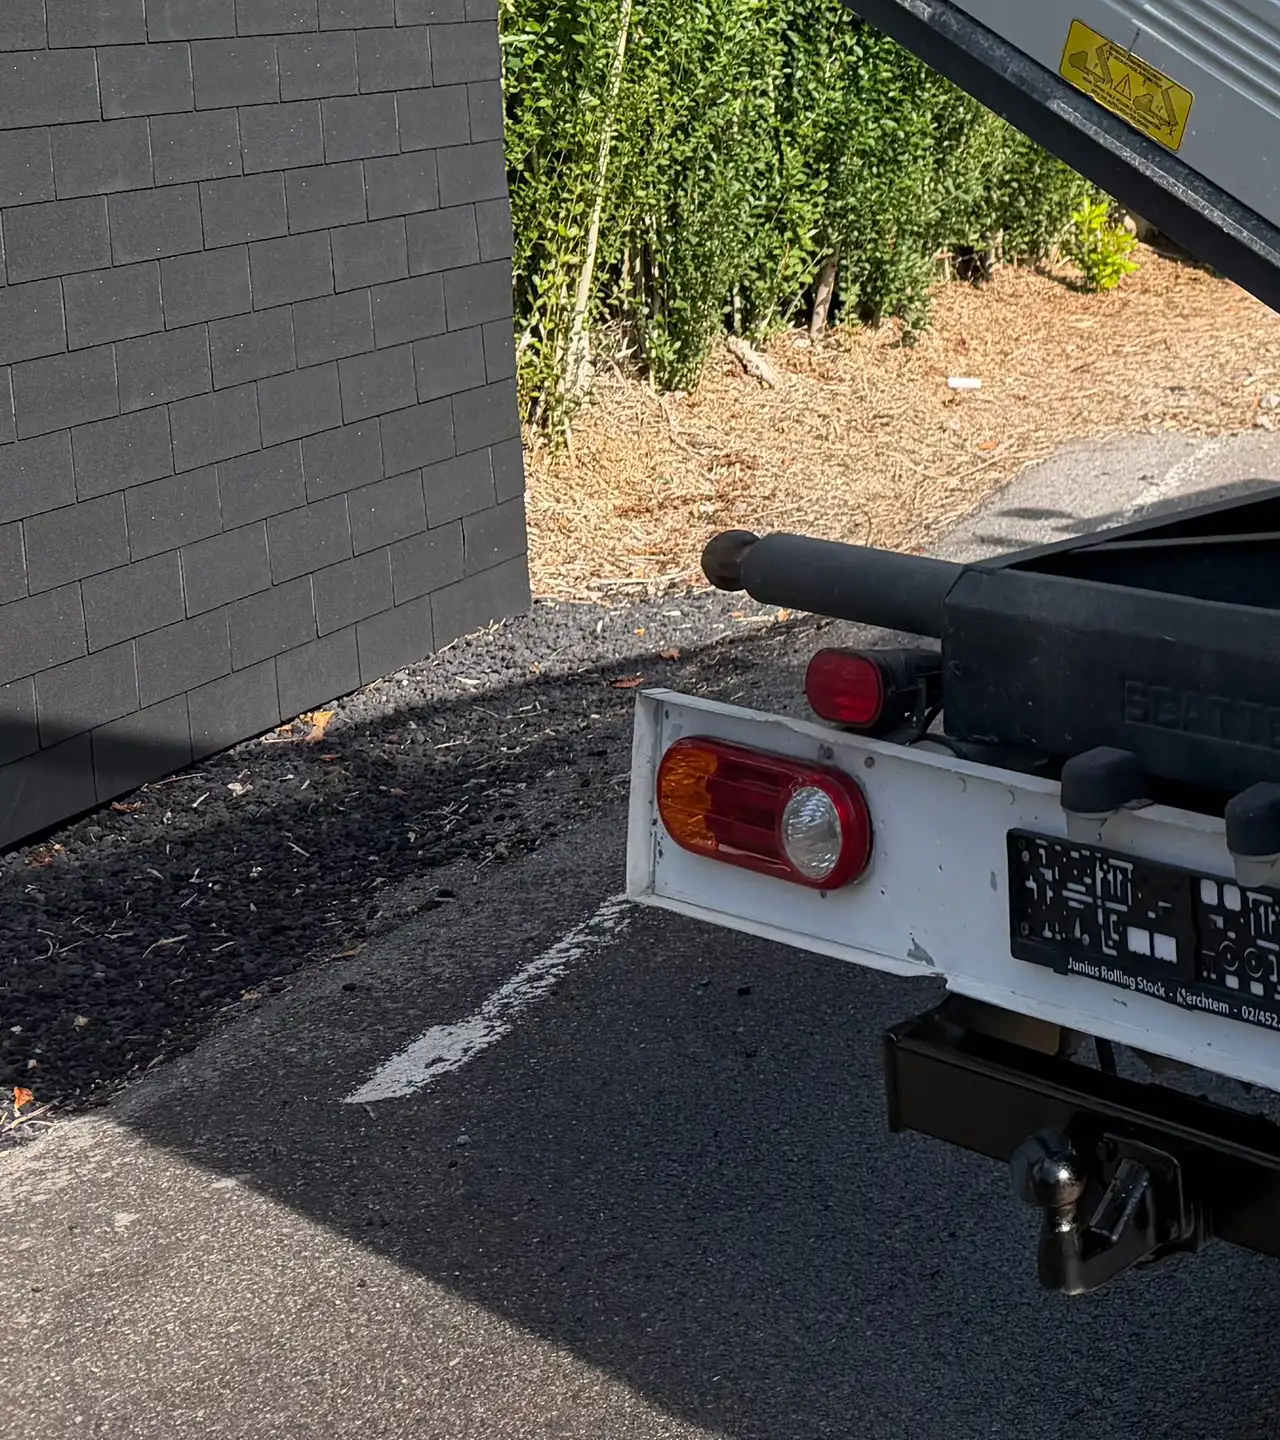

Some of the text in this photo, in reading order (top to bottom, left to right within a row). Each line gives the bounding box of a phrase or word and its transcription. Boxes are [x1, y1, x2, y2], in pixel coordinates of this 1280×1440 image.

[1067, 956, 1100, 978] Junius
[1101, 965, 1136, 990] Rolling
[1137, 975, 1166, 997] Stock
